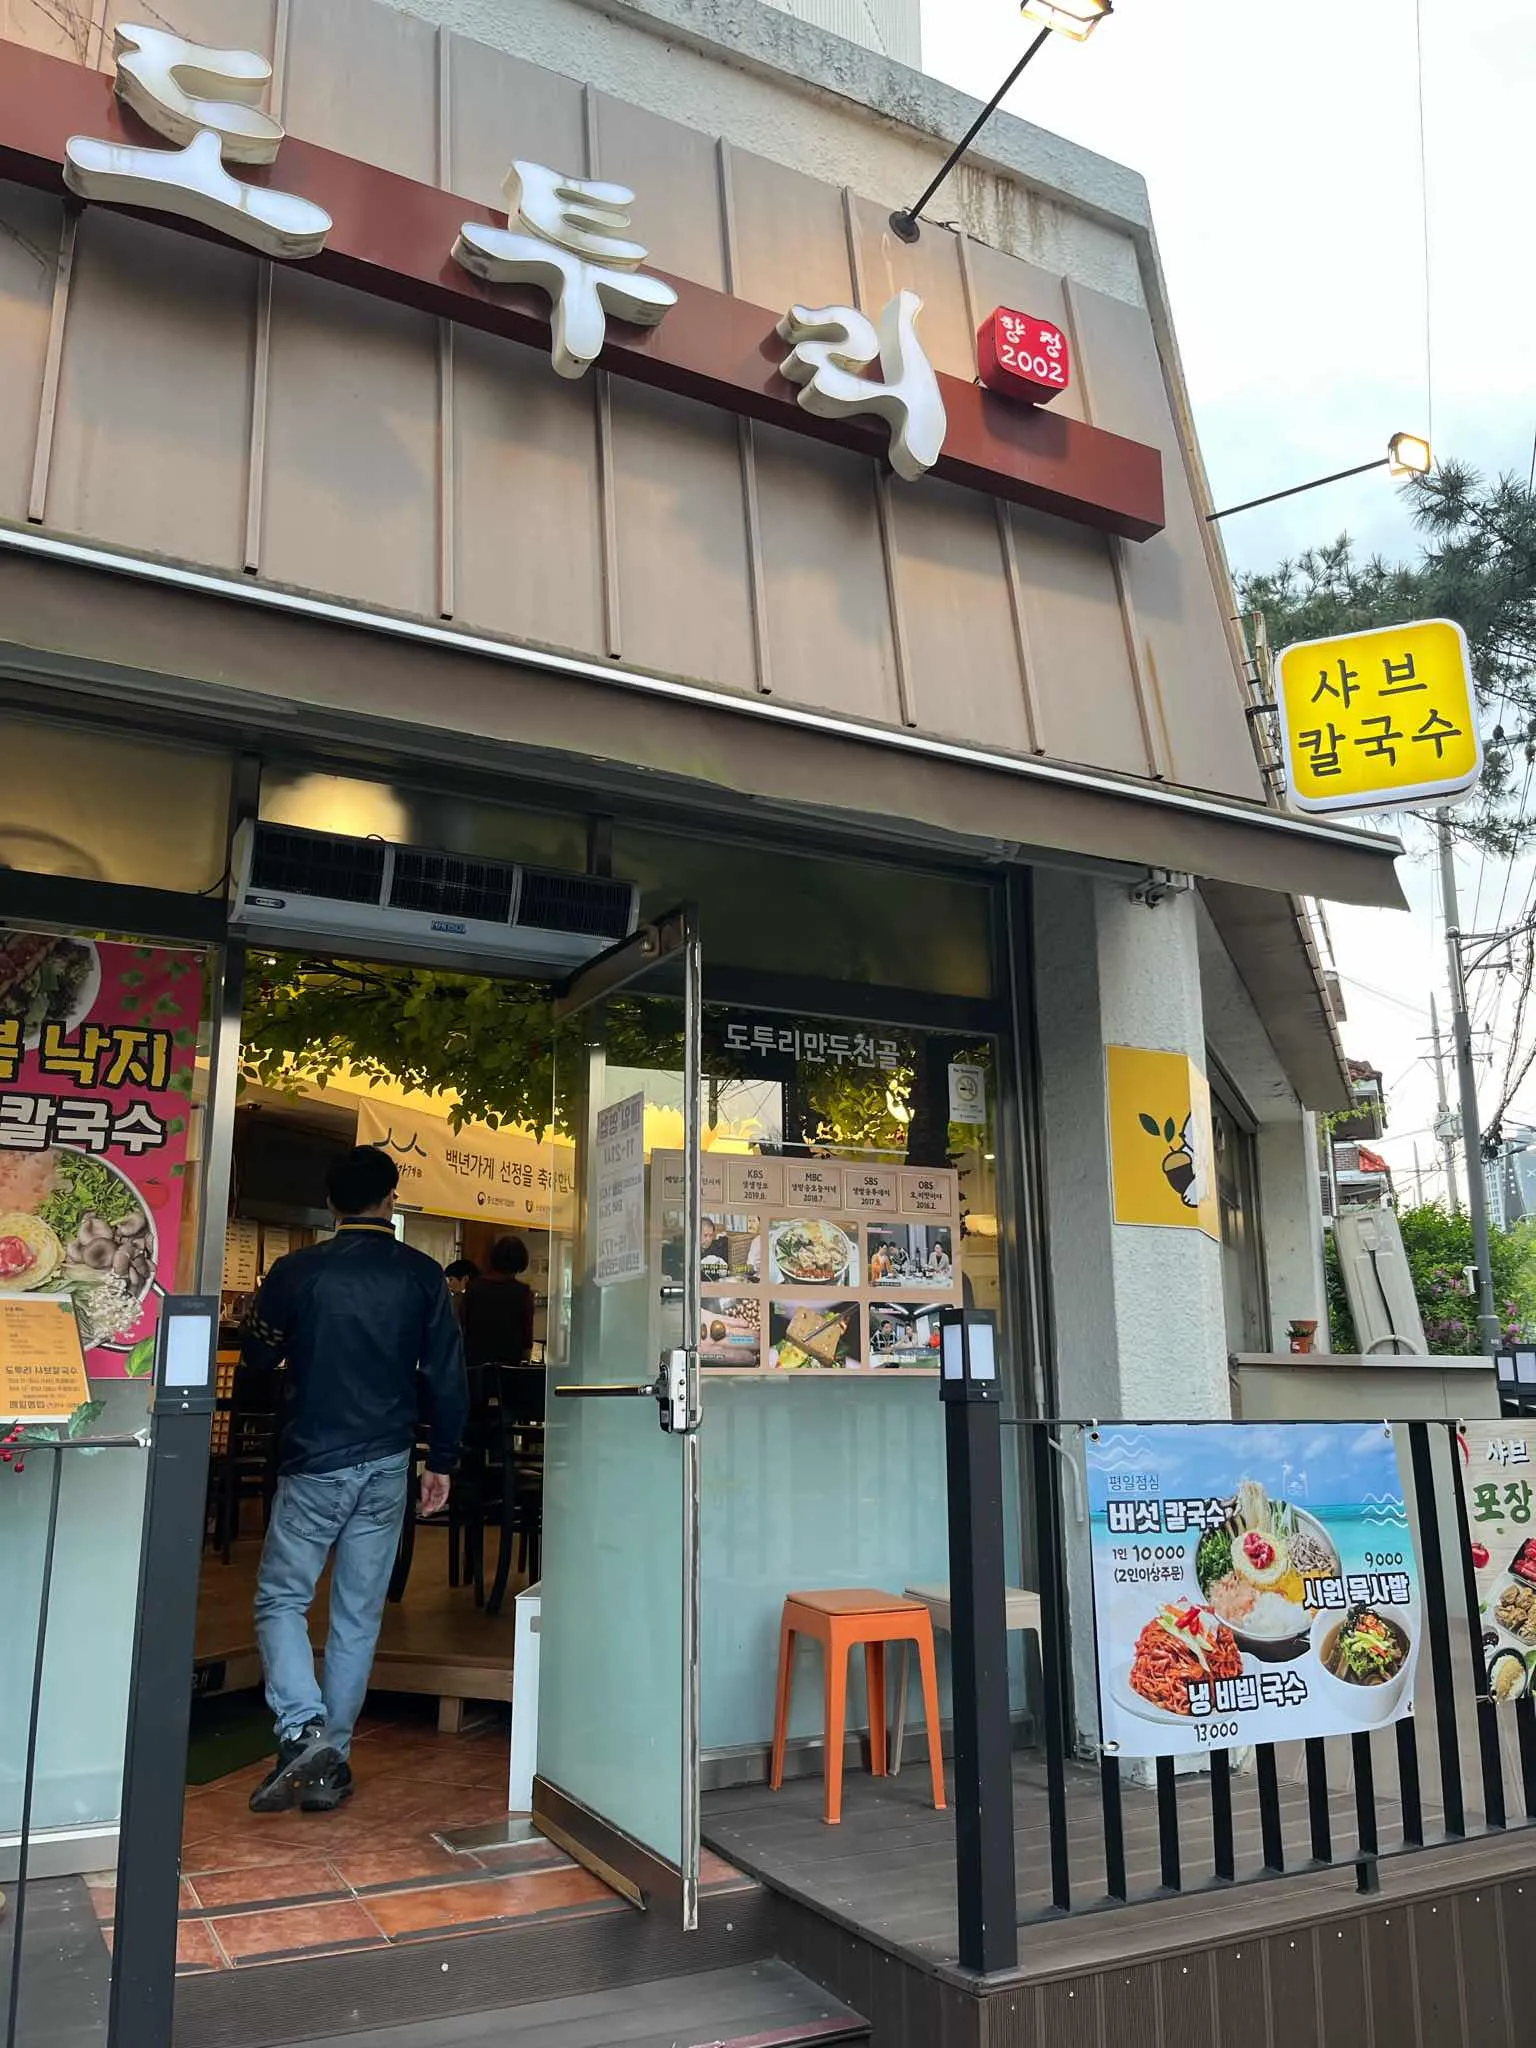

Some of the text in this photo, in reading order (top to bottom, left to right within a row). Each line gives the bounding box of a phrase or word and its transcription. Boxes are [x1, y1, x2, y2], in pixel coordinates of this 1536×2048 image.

[63, 22, 948, 481] 도투리
[1001, 345, 1065, 383] 2002
[1311, 653, 1428, 709] 샤브
[1298, 708, 1462, 777] 칼국수
[42, 1022, 171, 1090] 낙지
[0, 1094, 166, 1153] 칼국수
[446, 1149, 495, 1180] 백년가게
[500, 1160, 533, 1188] 선정을
[747, 1169, 764, 1179] KBS
[805, 1173, 823, 1182] MBC
[864, 1177, 879, 1186] SBS
[918, 1181, 934, 1190] OBS
[1488, 1440, 1531, 1467] 샤브
[1110, 1475, 1160, 1491] 평일점심
[1108, 1499, 1227, 1533] 버섯 칼국수
[1473, 1479, 1533, 1524] 포장
[1112, 1548, 1128, 1560] 1인
[1114, 1566, 1184, 1583] (2인이상주문)
[1303, 1573, 1410, 1609] 시원 묵사발
[1188, 1681, 1213, 1716] 냉
